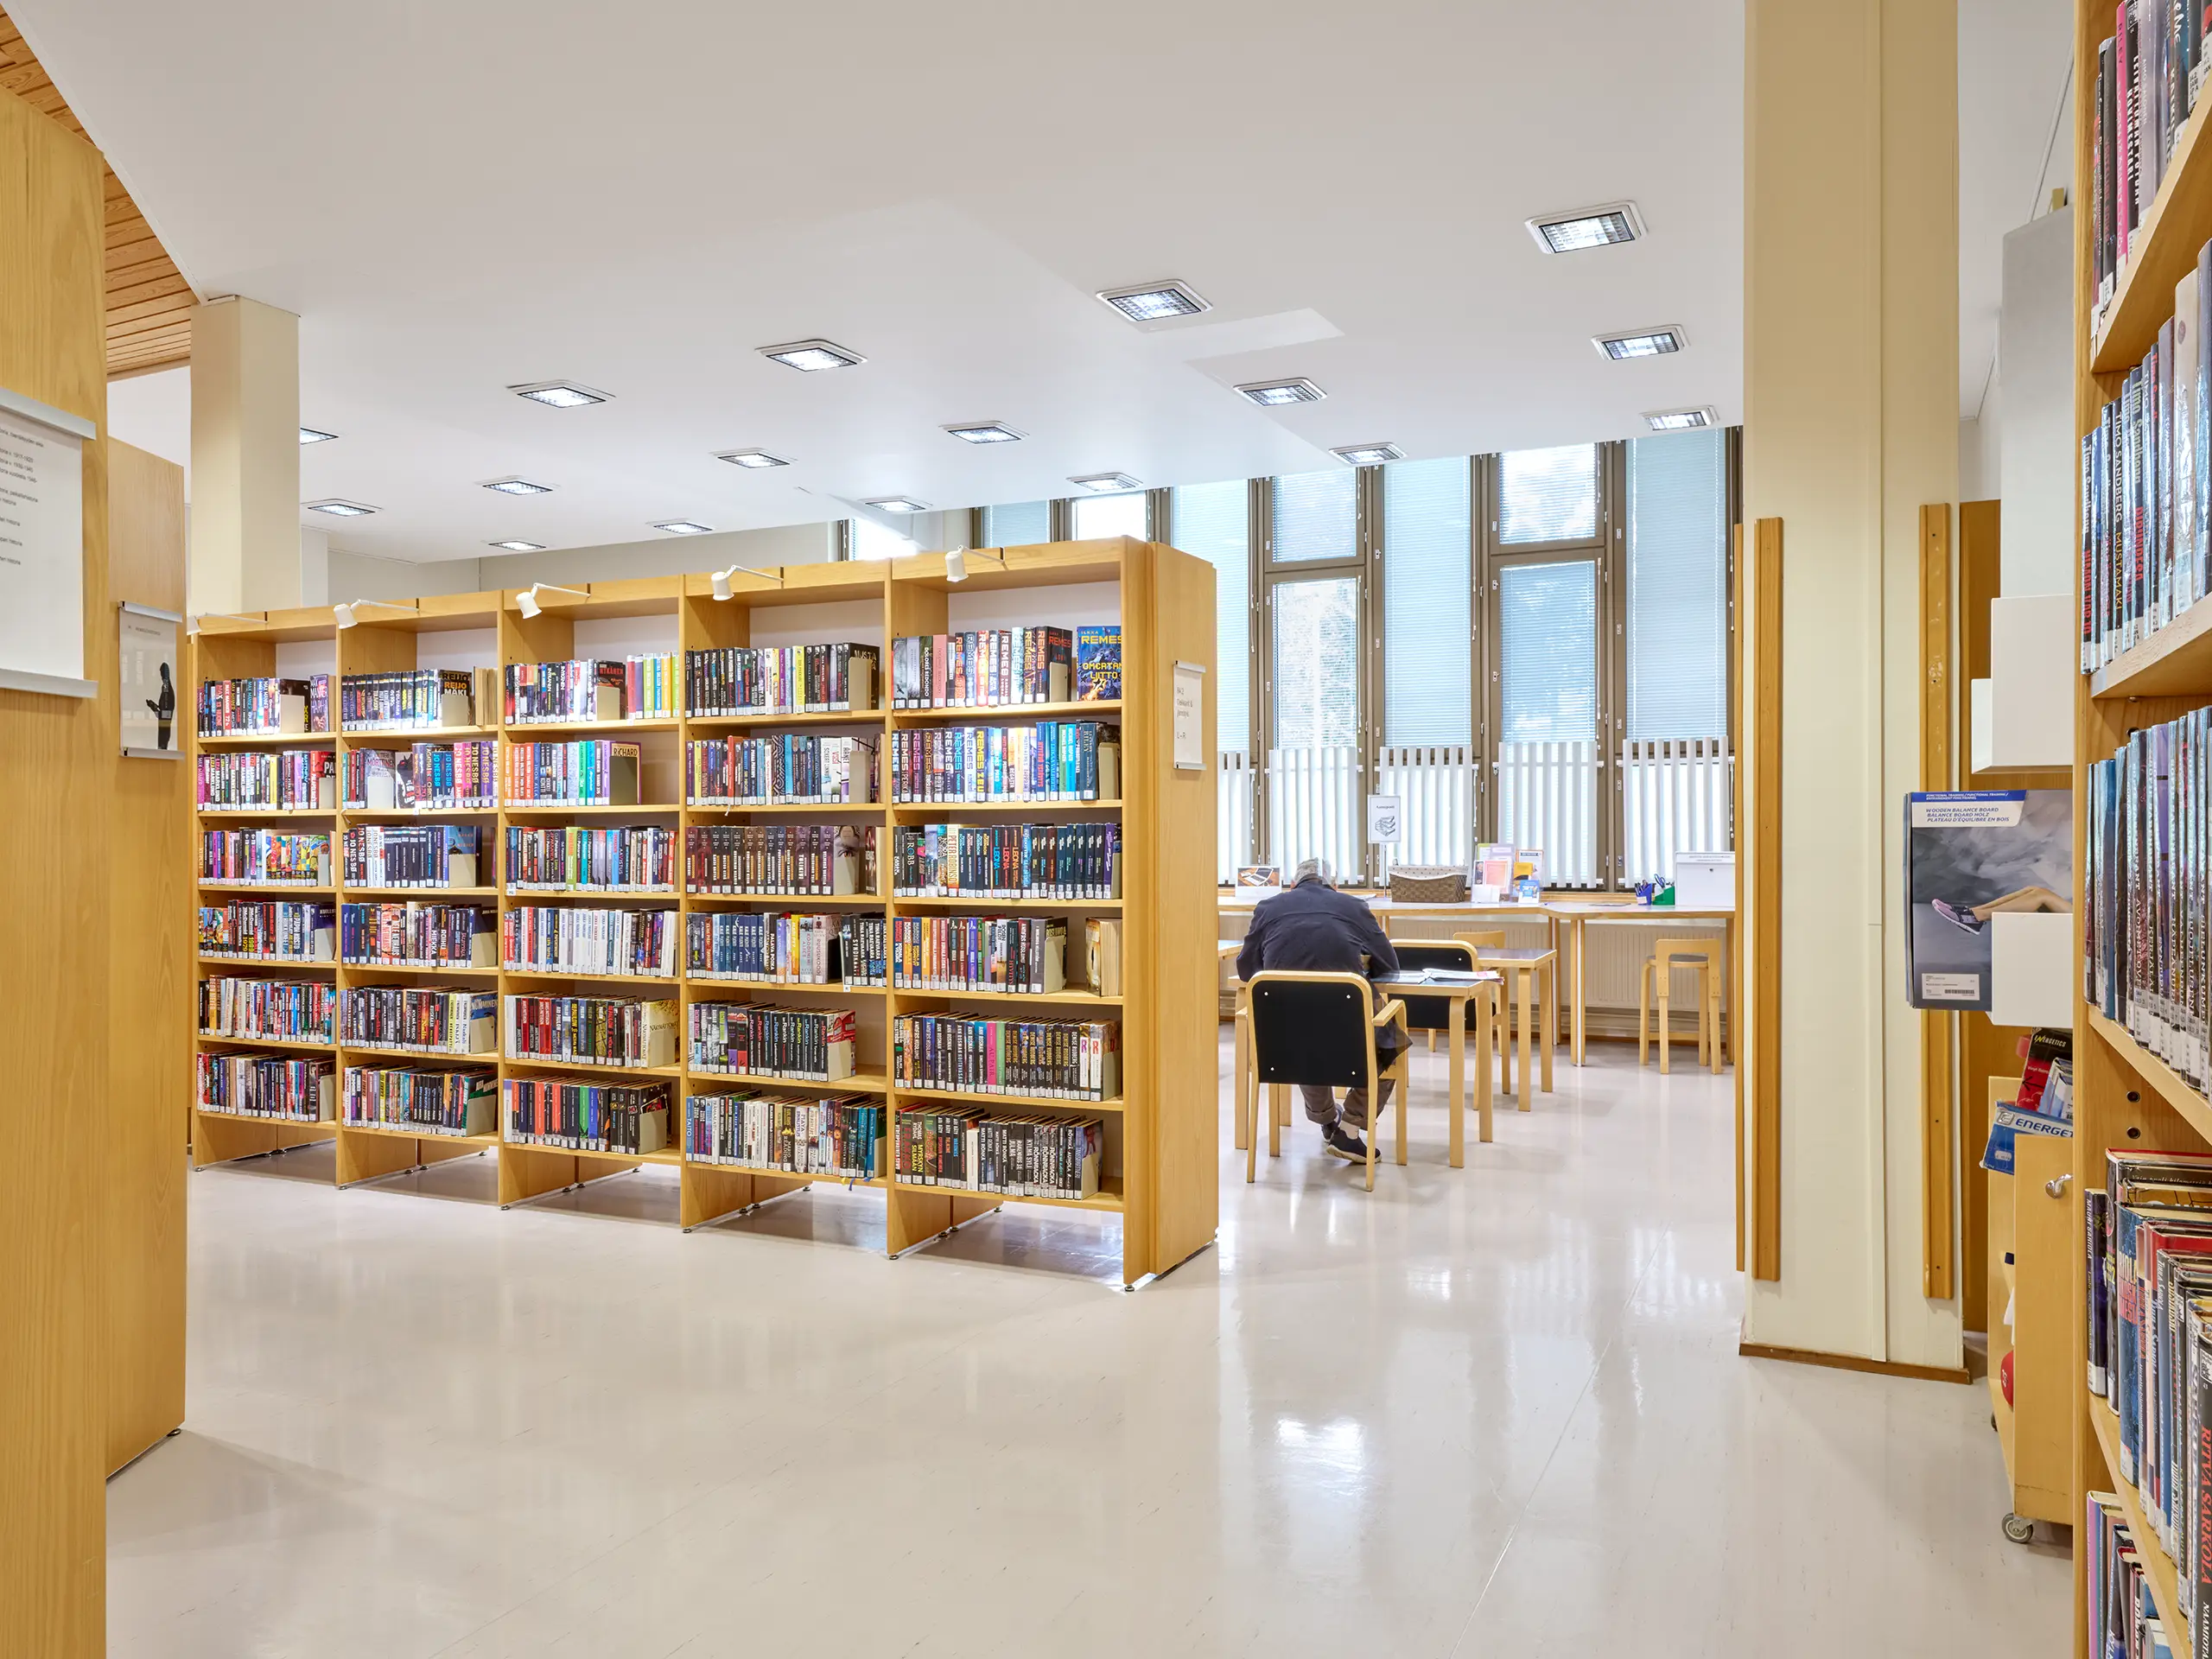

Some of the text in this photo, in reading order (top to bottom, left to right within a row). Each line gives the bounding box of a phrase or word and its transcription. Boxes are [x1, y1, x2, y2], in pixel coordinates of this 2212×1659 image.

[2114, 451, 2123, 523] SANDBERG
[1081, 636, 1121, 645] REMES
[472, 747, 479, 755] JO
[482, 747, 489, 755] JO
[613, 747, 638, 757] RICHARD
[434, 753, 440, 762] JO
[446, 753, 451, 762] JO
[949, 835, 957, 854] PETER
[906, 842, 915, 865] ROBB
[2201, 1425, 2212, 1585] RITVA SARKOLA
